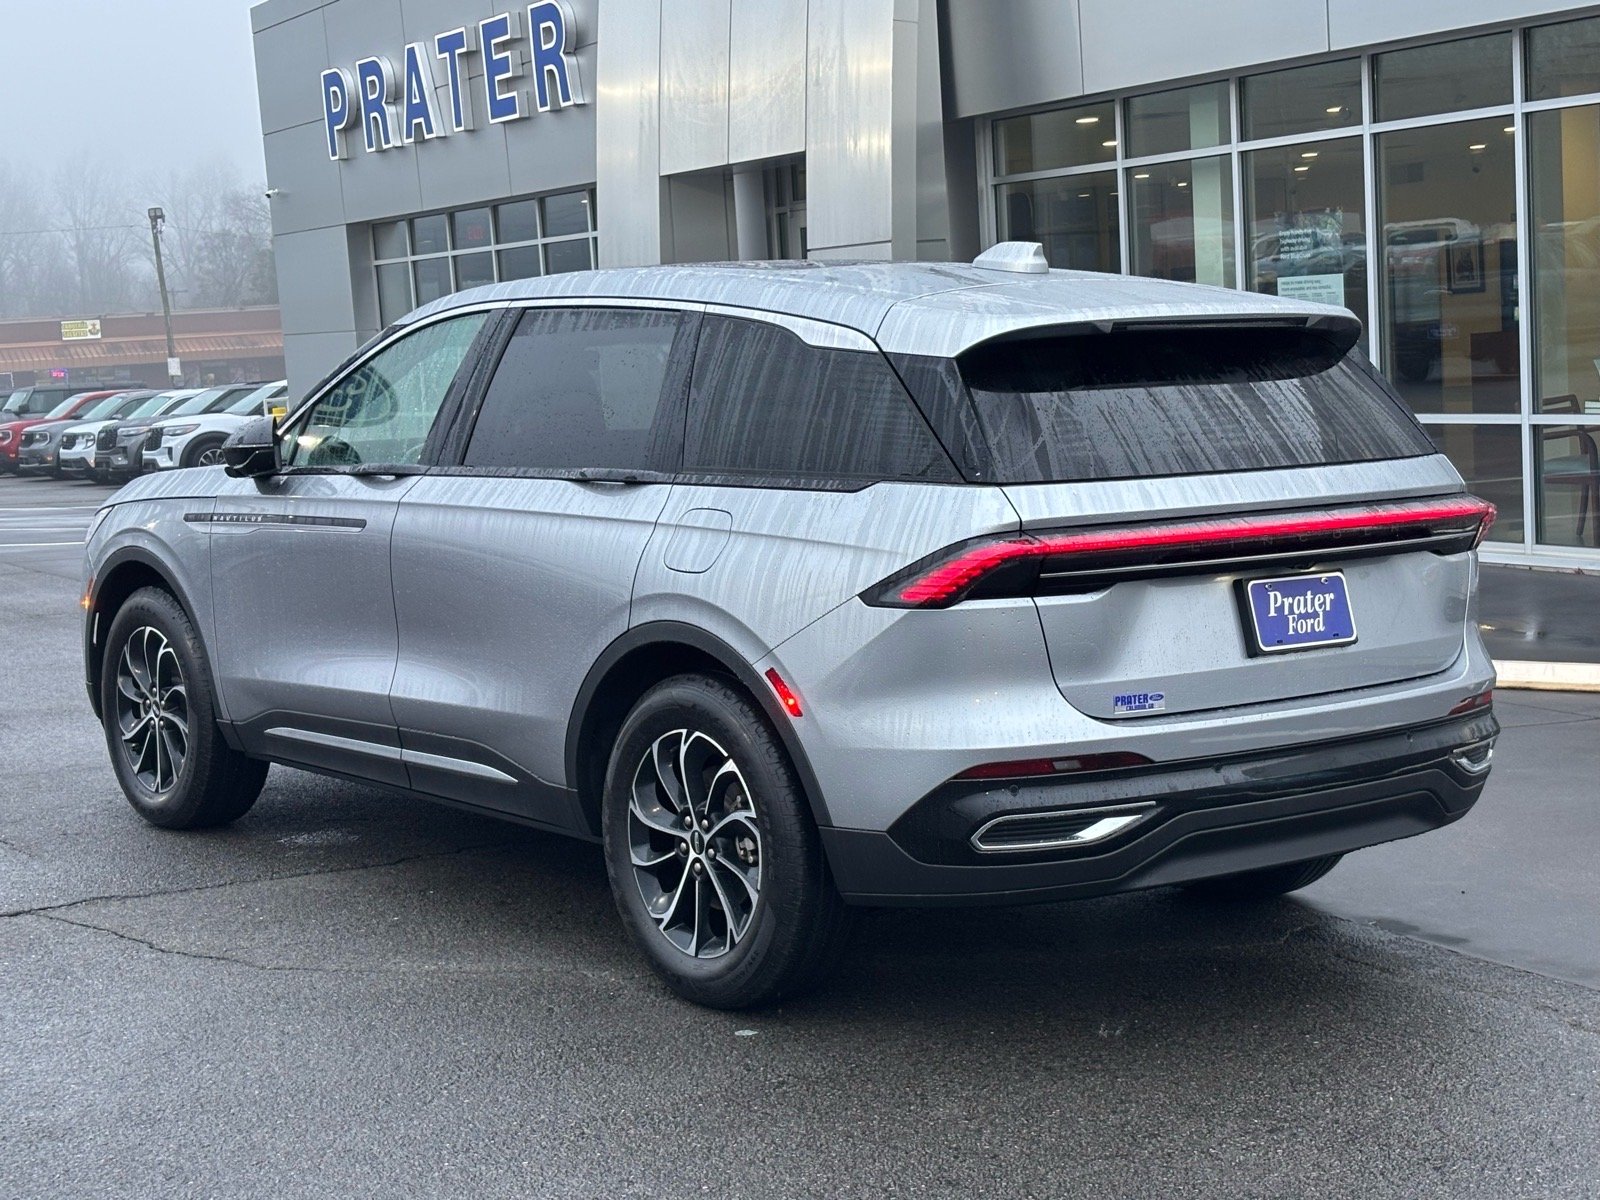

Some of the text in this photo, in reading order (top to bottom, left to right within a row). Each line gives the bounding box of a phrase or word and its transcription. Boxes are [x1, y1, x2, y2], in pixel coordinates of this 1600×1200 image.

[320, 0, 580, 160] PRATER
[212, 514, 263, 522] NAUTILUS
[1268, 590, 1335, 616] Prater
[1287, 611, 1326, 635] Ford
[1115, 693, 1149, 706] PRATER
